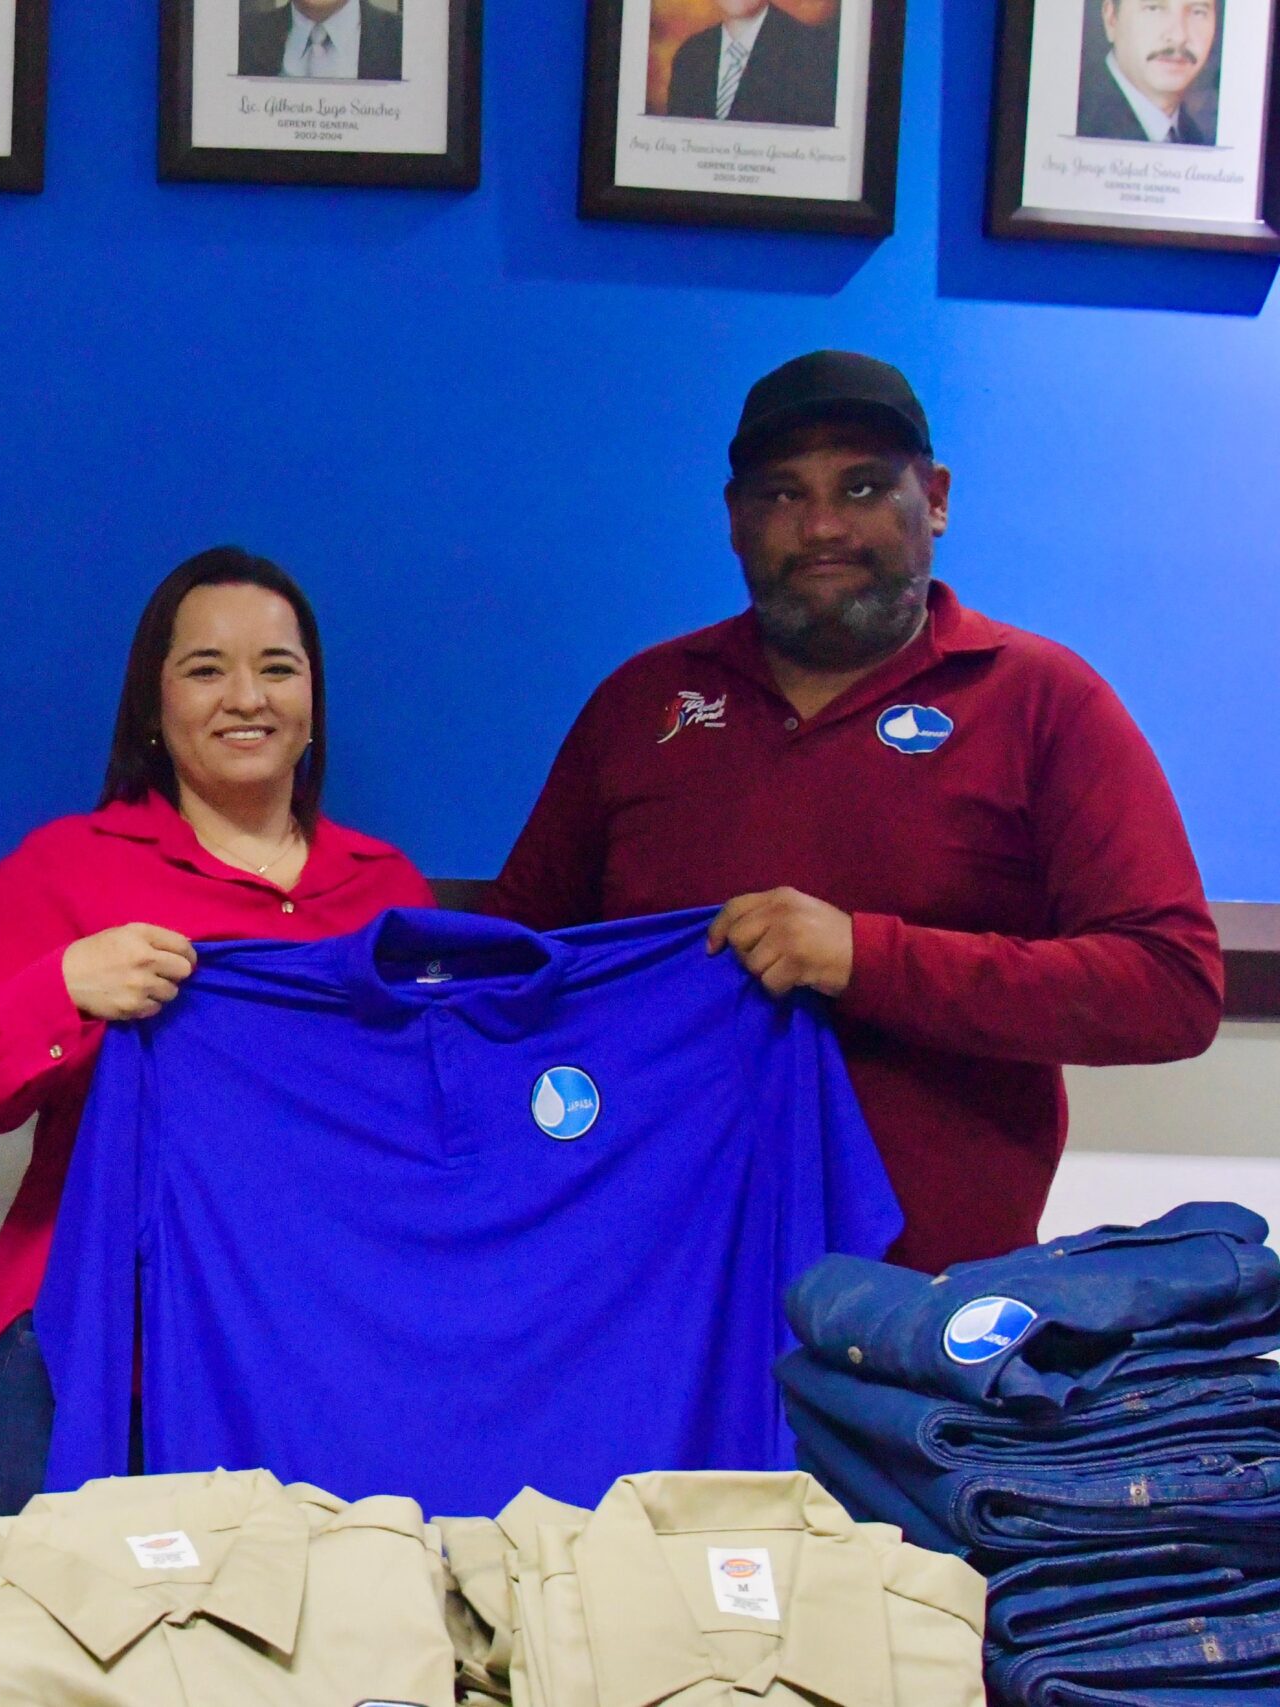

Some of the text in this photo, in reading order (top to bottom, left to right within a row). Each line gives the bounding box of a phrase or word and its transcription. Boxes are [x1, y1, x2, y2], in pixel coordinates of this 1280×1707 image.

[264, 95, 313, 116] Gilberto
[316, 98, 346, 118] Lugo
[277, 120, 359, 130] GERENTE GENERAL
[697, 161, 776, 174] GERENTE GENERAL
[1104, 181, 1180, 194] GERENTE GENERAL
[737, 1583, 750, 1593] M
